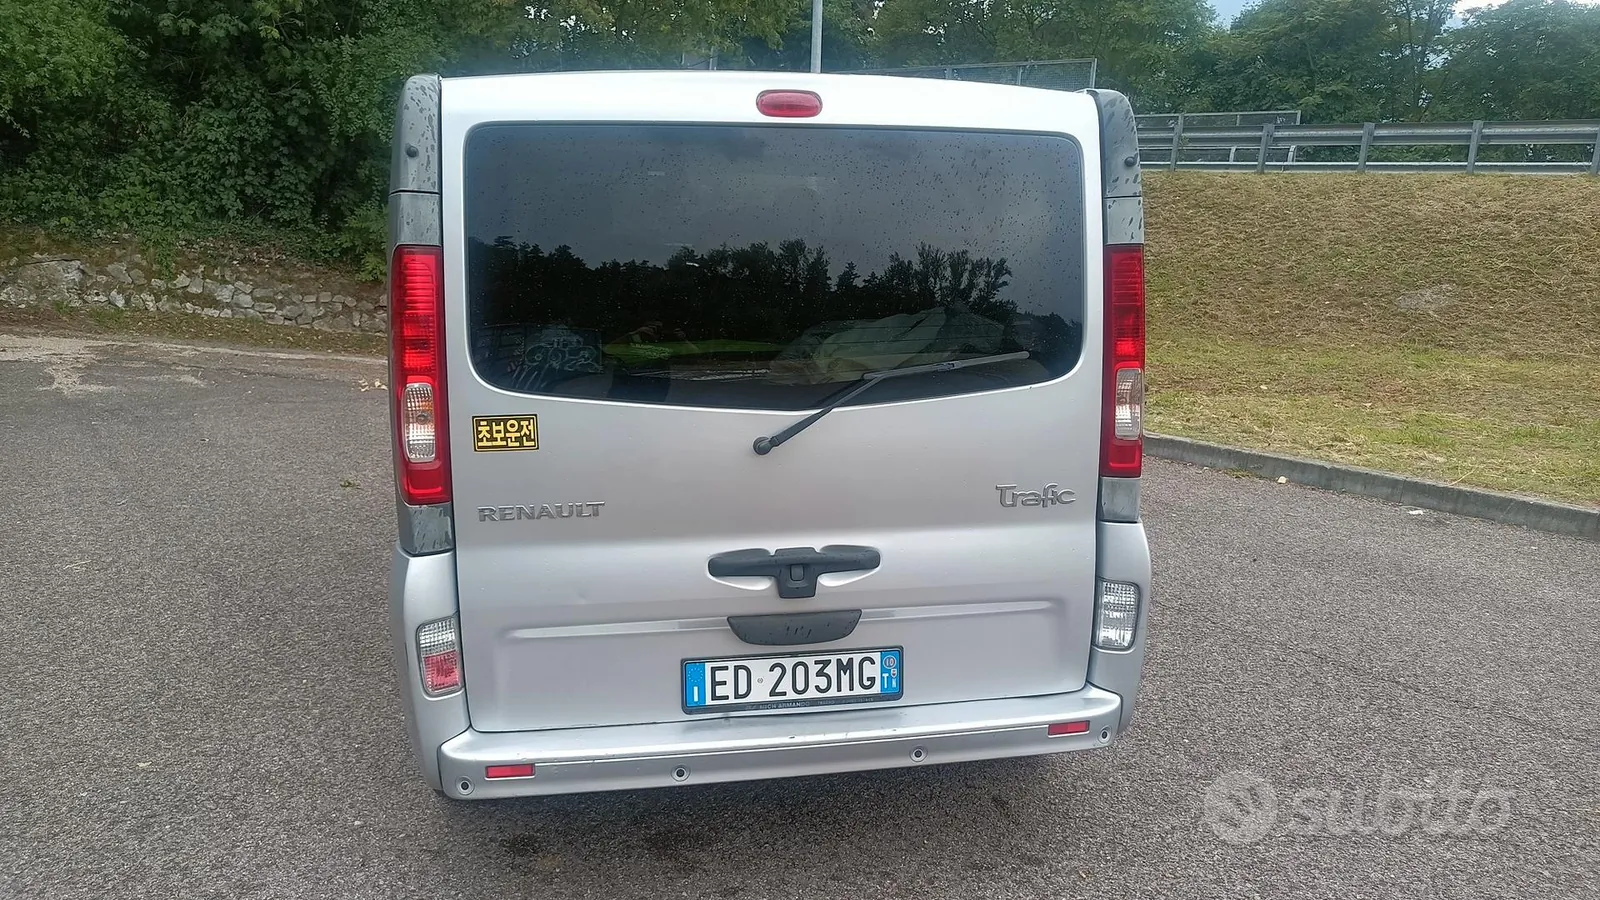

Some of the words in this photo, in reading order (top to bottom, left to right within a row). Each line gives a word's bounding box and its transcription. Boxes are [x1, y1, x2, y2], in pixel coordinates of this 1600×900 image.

[477, 418, 535, 447] 초보운전
[995, 482, 1076, 508] Trafic
[477, 501, 605, 522] RENAULT
[710, 664, 752, 701] ED
[768, 656, 876, 698] 203MG
